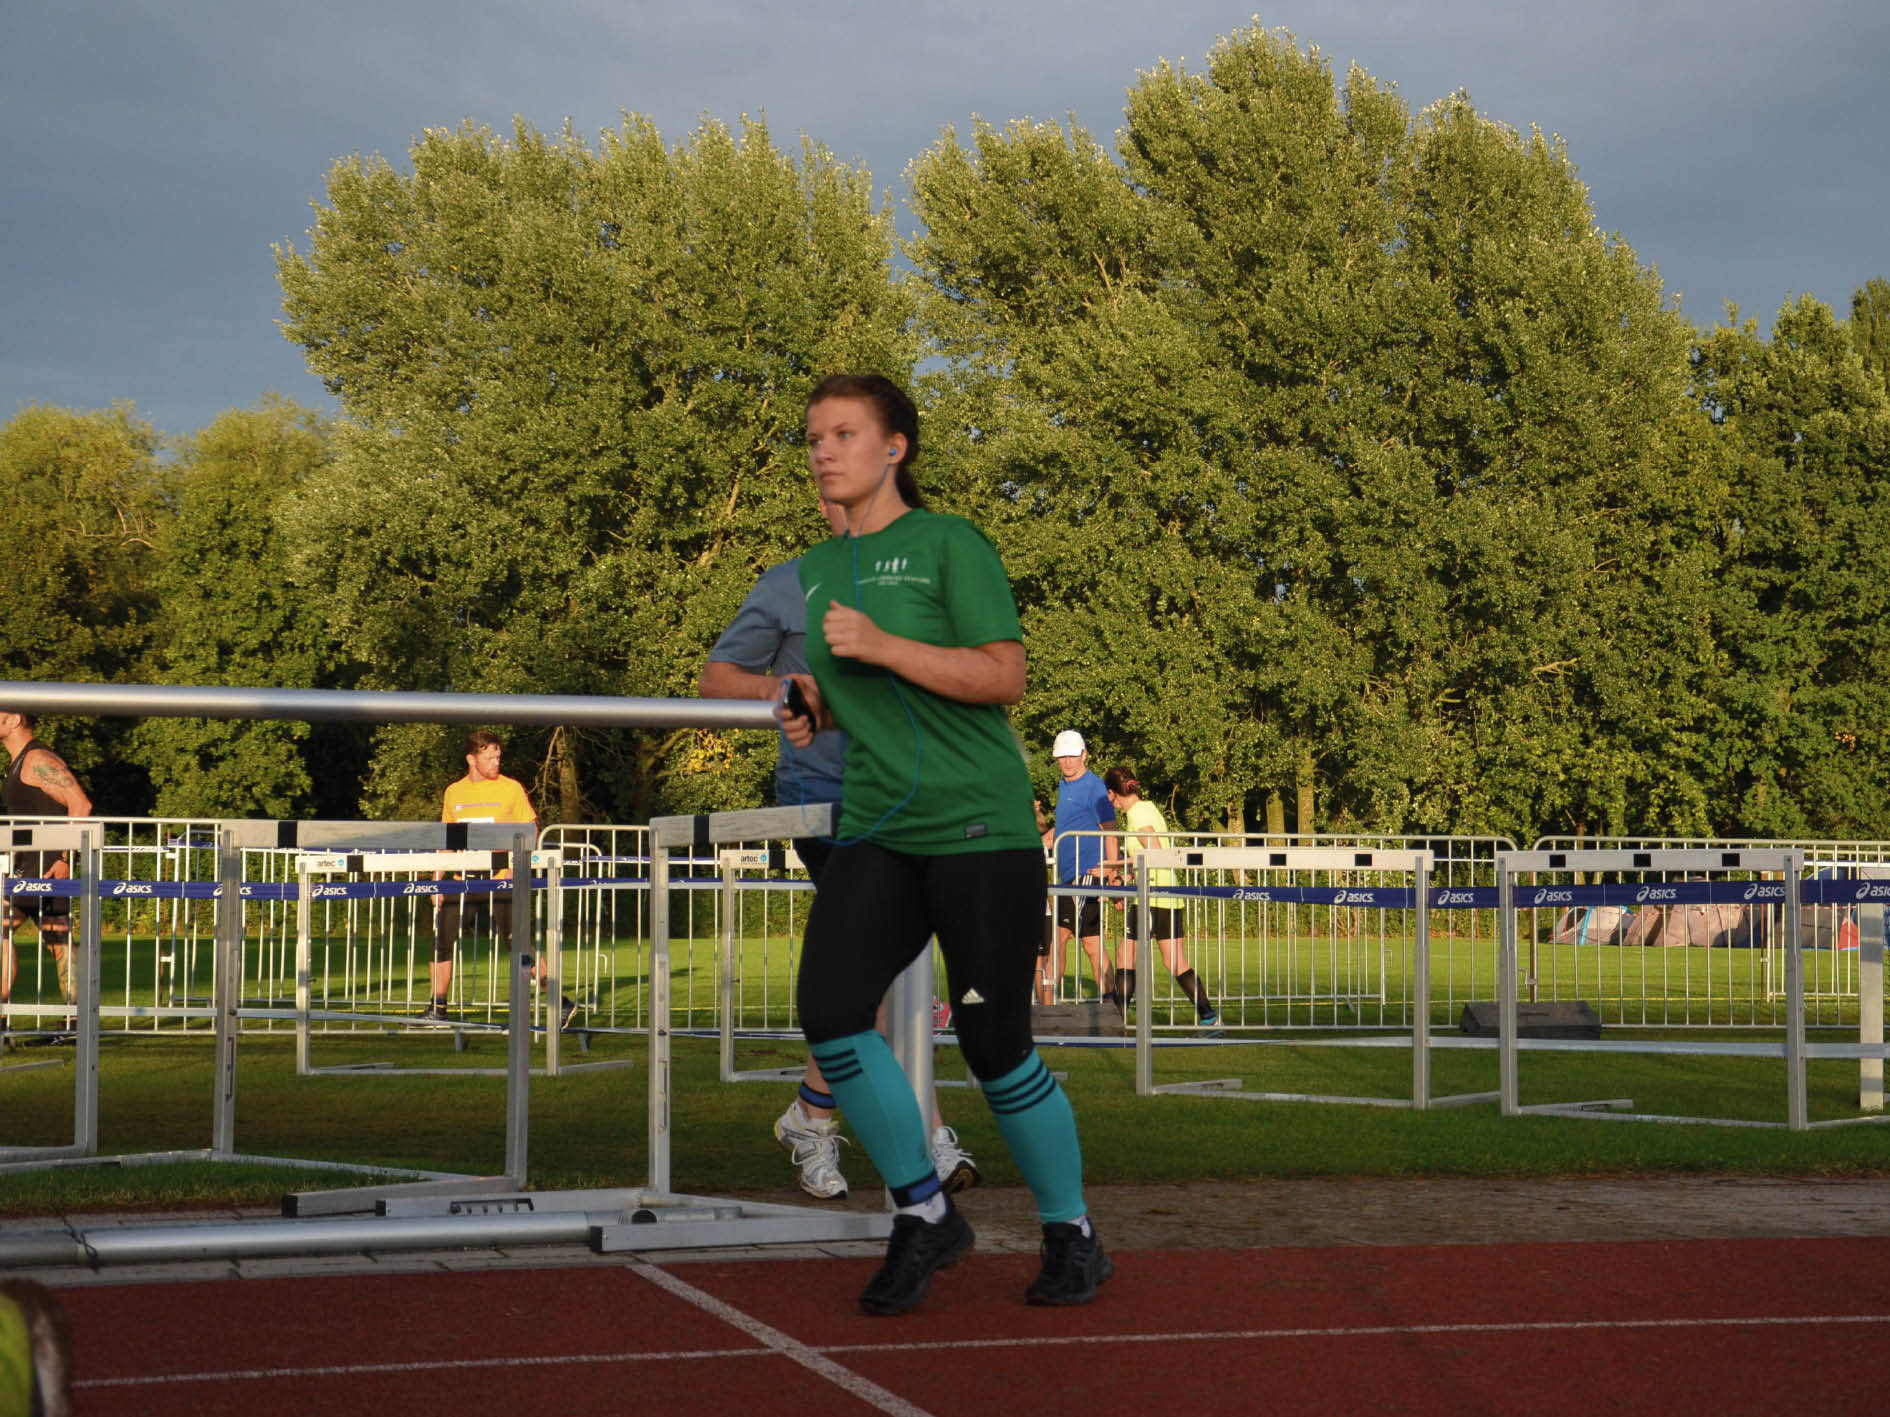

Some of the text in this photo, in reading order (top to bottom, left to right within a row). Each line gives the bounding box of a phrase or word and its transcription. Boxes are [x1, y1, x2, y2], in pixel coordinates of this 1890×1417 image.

[1347, 892, 1374, 903] asics
[1449, 892, 1474, 903] asics
[1546, 890, 1573, 902] asics
[1649, 888, 1677, 900] asics
